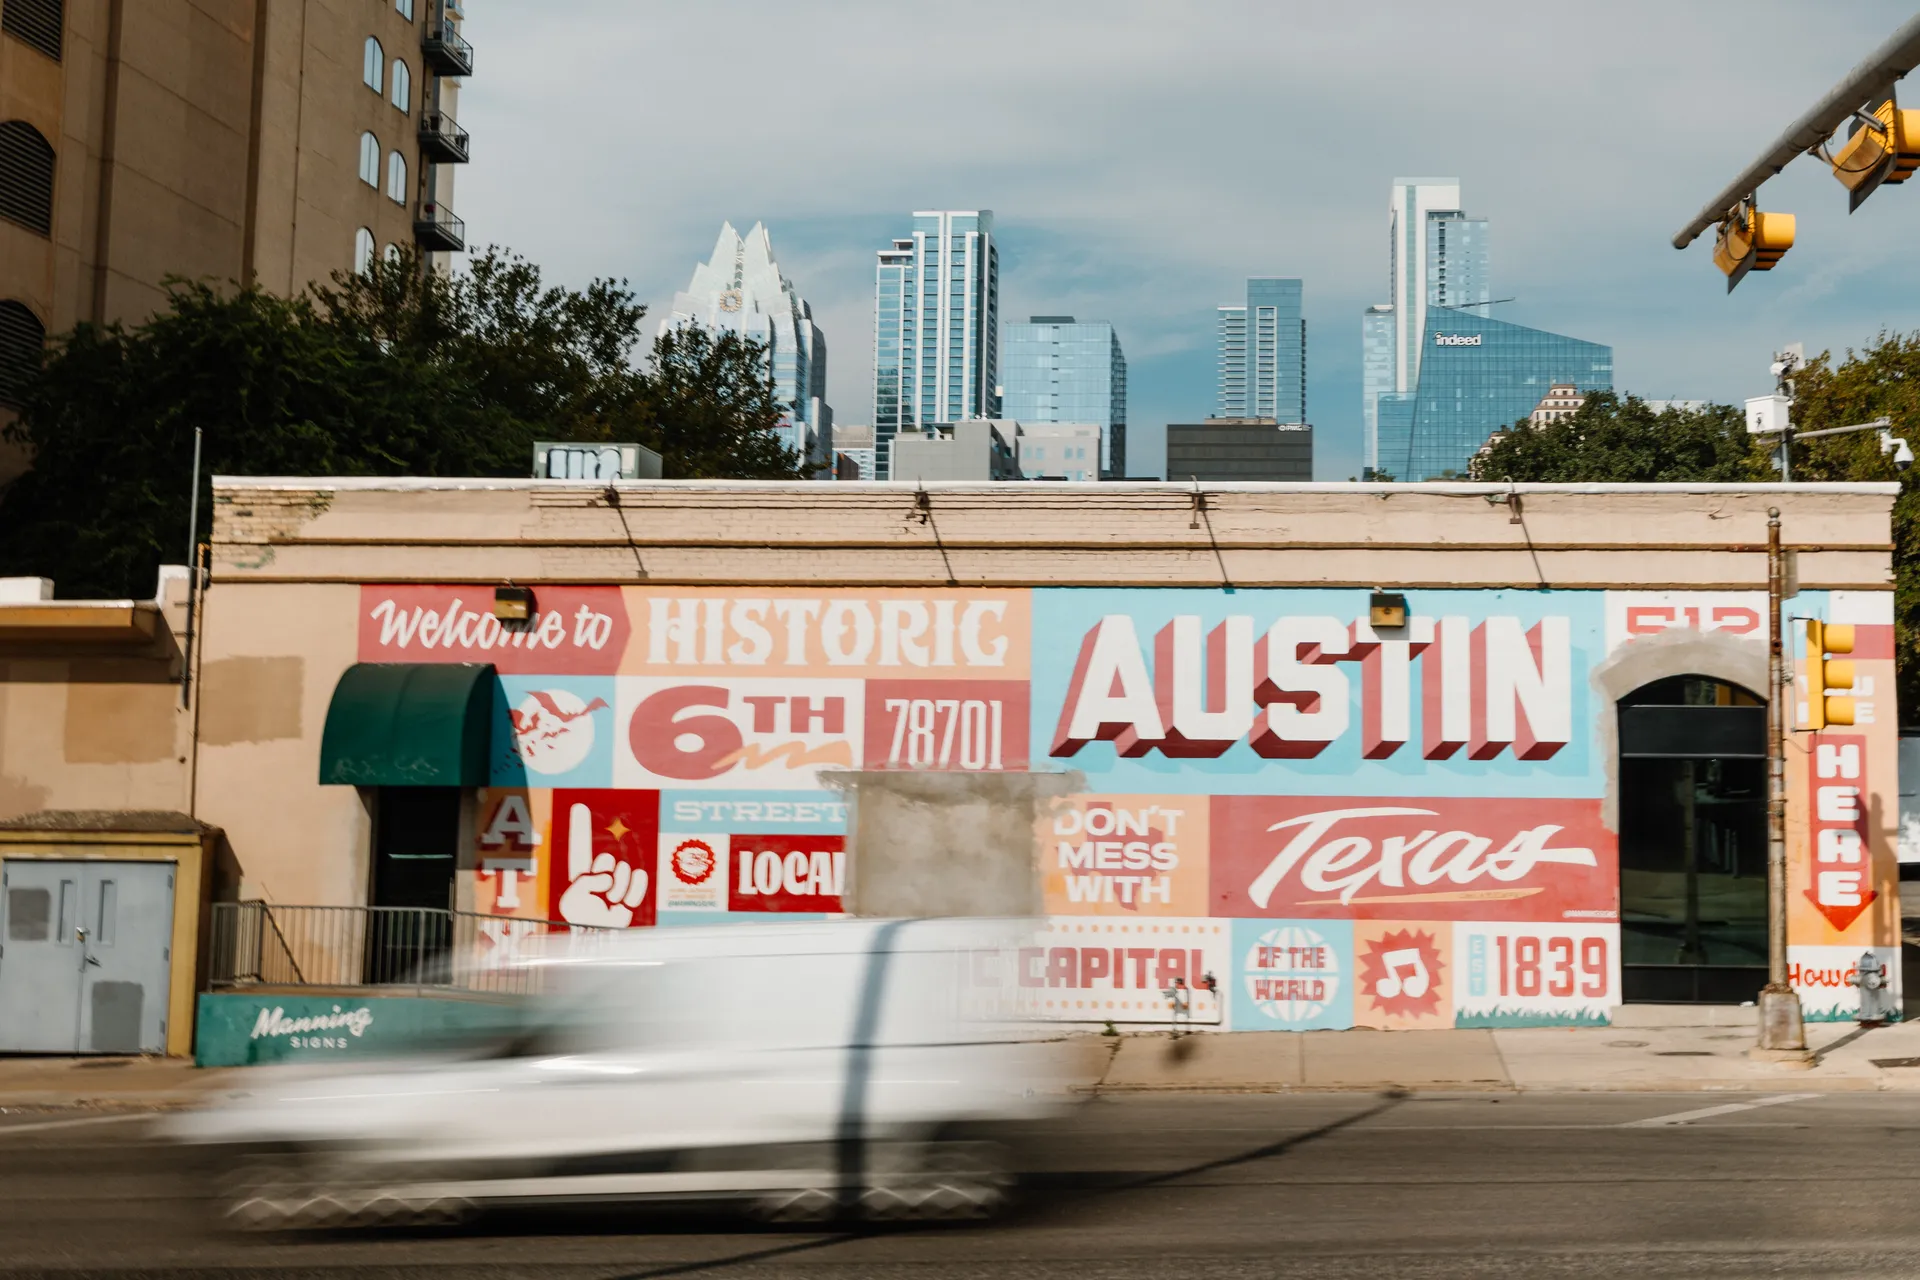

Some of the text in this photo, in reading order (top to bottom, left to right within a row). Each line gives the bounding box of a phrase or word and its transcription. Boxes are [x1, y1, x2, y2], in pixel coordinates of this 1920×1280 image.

[1434, 331, 1481, 346] indeed
[370, 598, 613, 650] Welcome to
[647, 597, 1009, 667] HISTORIC
[1049, 615, 1572, 760] AUSTIN
[629, 685, 845, 780] 6TH
[885, 699, 1004, 771] 78701
[673, 800, 850, 823] STREET
[1054, 807, 1184, 837] DON'T
[1816, 744, 1861, 906] HERE
[1058, 842, 1179, 870] MESS
[1248, 807, 1598, 909] Texas
[1064, 875, 1170, 903] WITH
[1018, 947, 1214, 988] CAPITAL
[1288, 946, 1326, 968] THE
[1497, 936, 1607, 998] 1839
[1255, 979, 1325, 1001] WORLD
[251, 1006, 373, 1039] Manning
[290, 1036, 348, 1049] SIGNS
